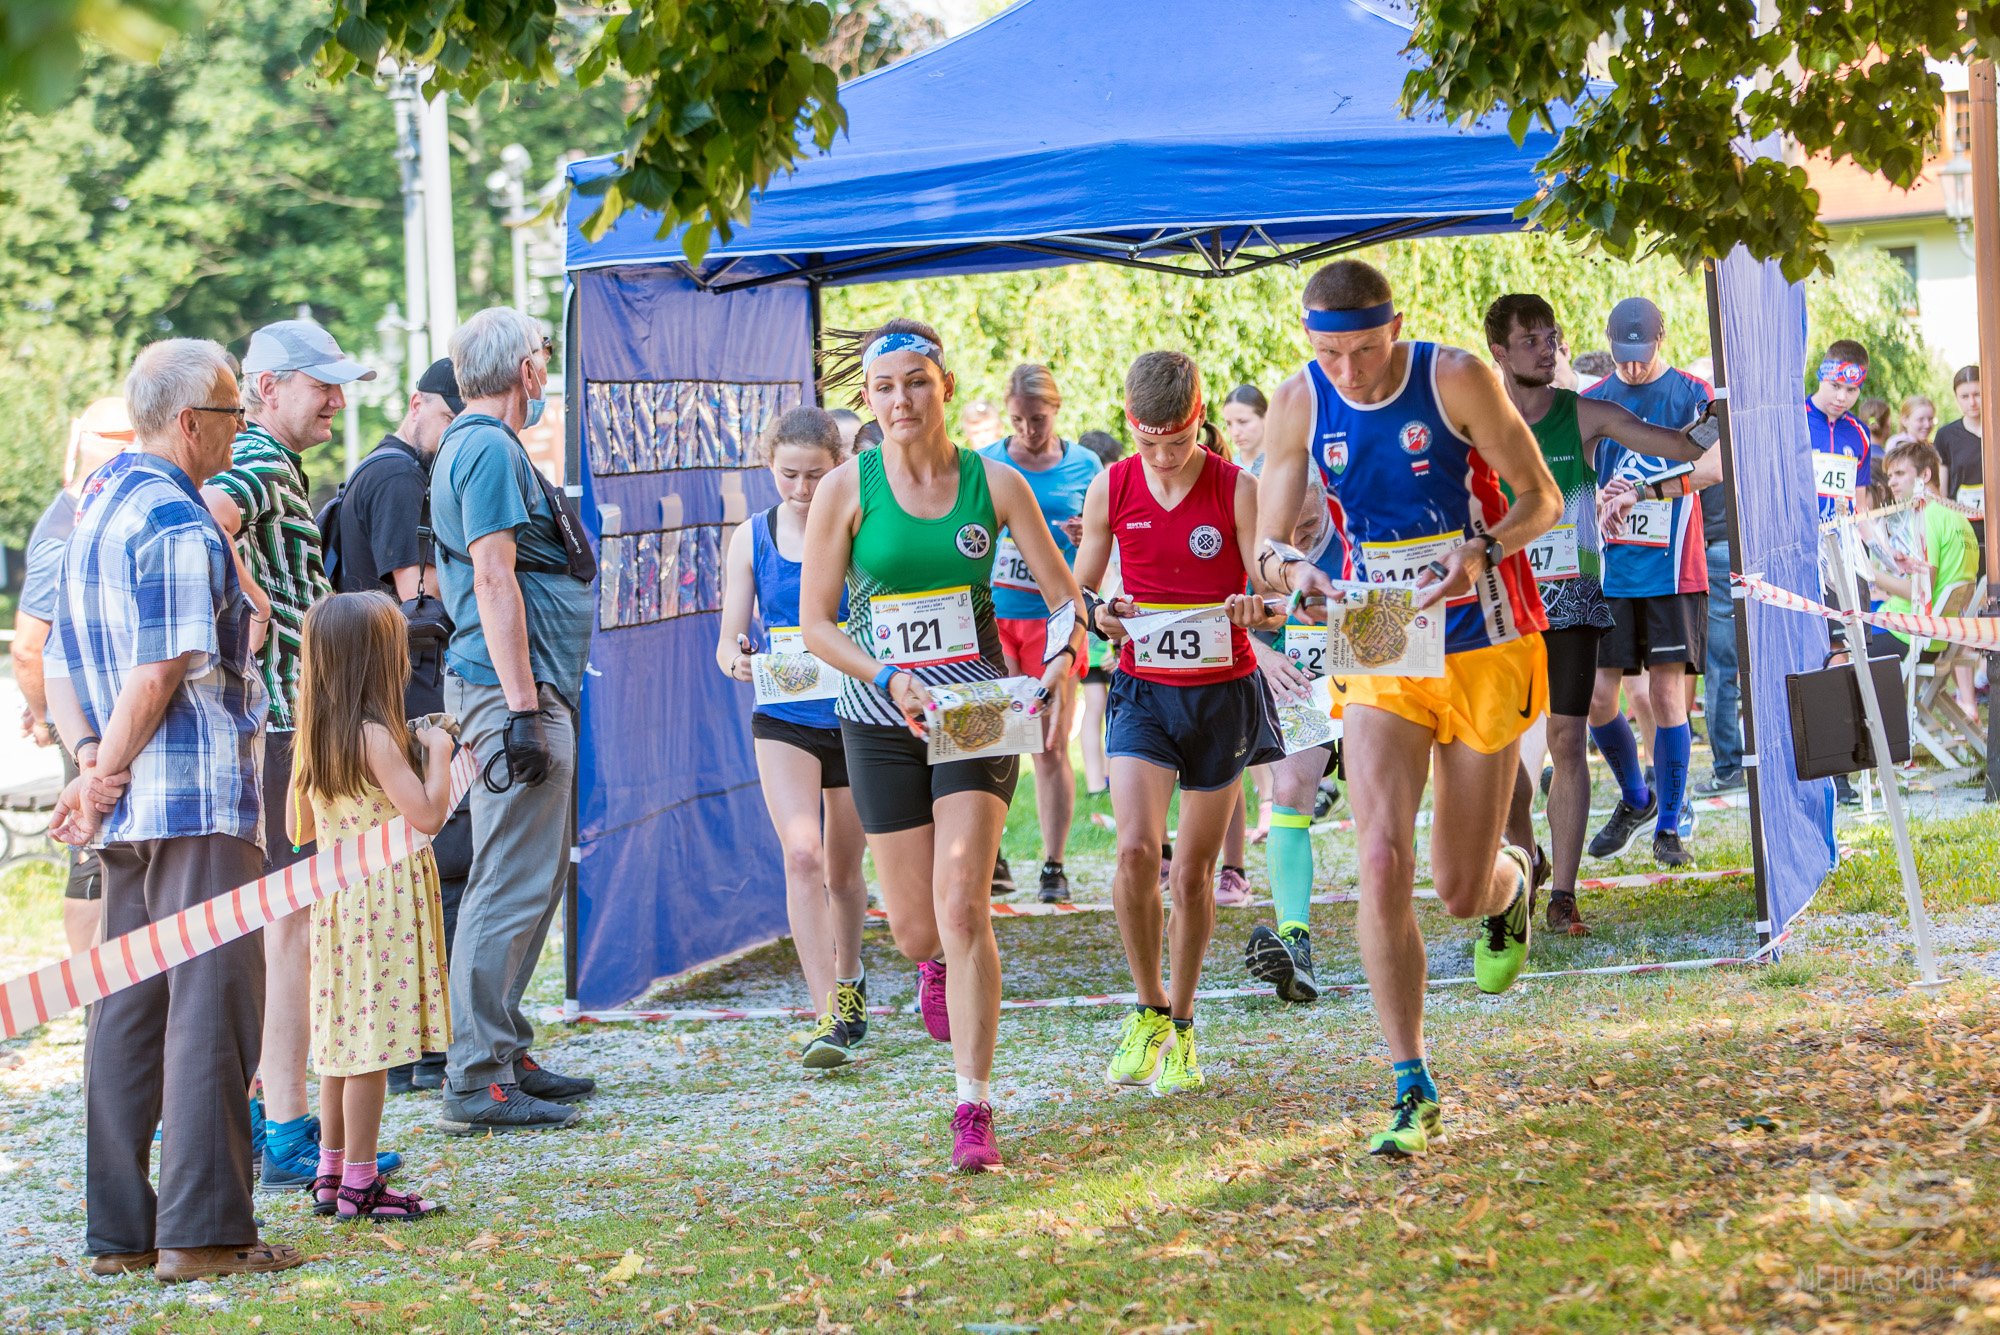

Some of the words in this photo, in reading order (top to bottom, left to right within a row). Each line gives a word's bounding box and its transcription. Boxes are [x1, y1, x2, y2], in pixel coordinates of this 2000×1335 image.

[1822, 470, 1846, 489] 45
[1626, 514, 1649, 535] 12
[1010, 558, 1036, 582] 18
[897, 618, 942, 654] 121
[1157, 629, 1201, 660] 43
[1308, 647, 1327, 669] 2
